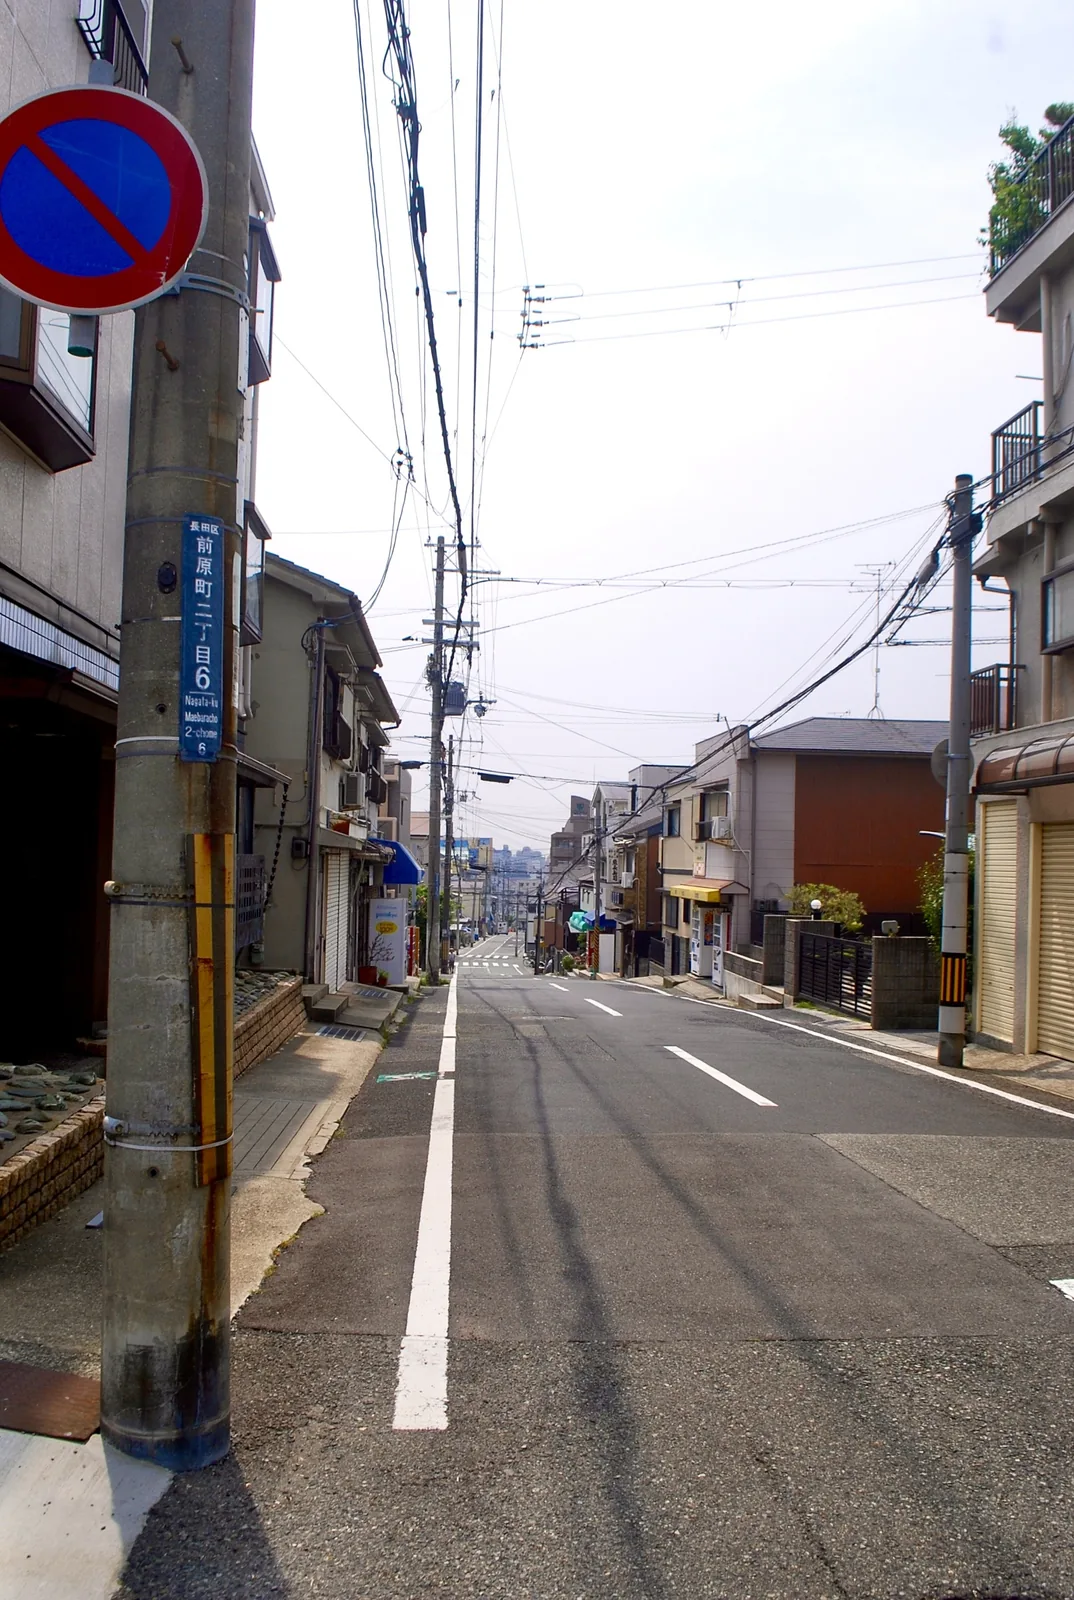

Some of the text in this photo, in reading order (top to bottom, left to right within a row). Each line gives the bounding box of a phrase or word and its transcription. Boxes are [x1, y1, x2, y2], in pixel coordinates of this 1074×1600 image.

[190, 520, 219, 535] 長田区
[185, 695, 219, 708] Nagata-ku
[185, 711, 218, 724] Maebaracho
[185, 726, 218, 738] 2-chome
[198, 742, 206, 755] 6
